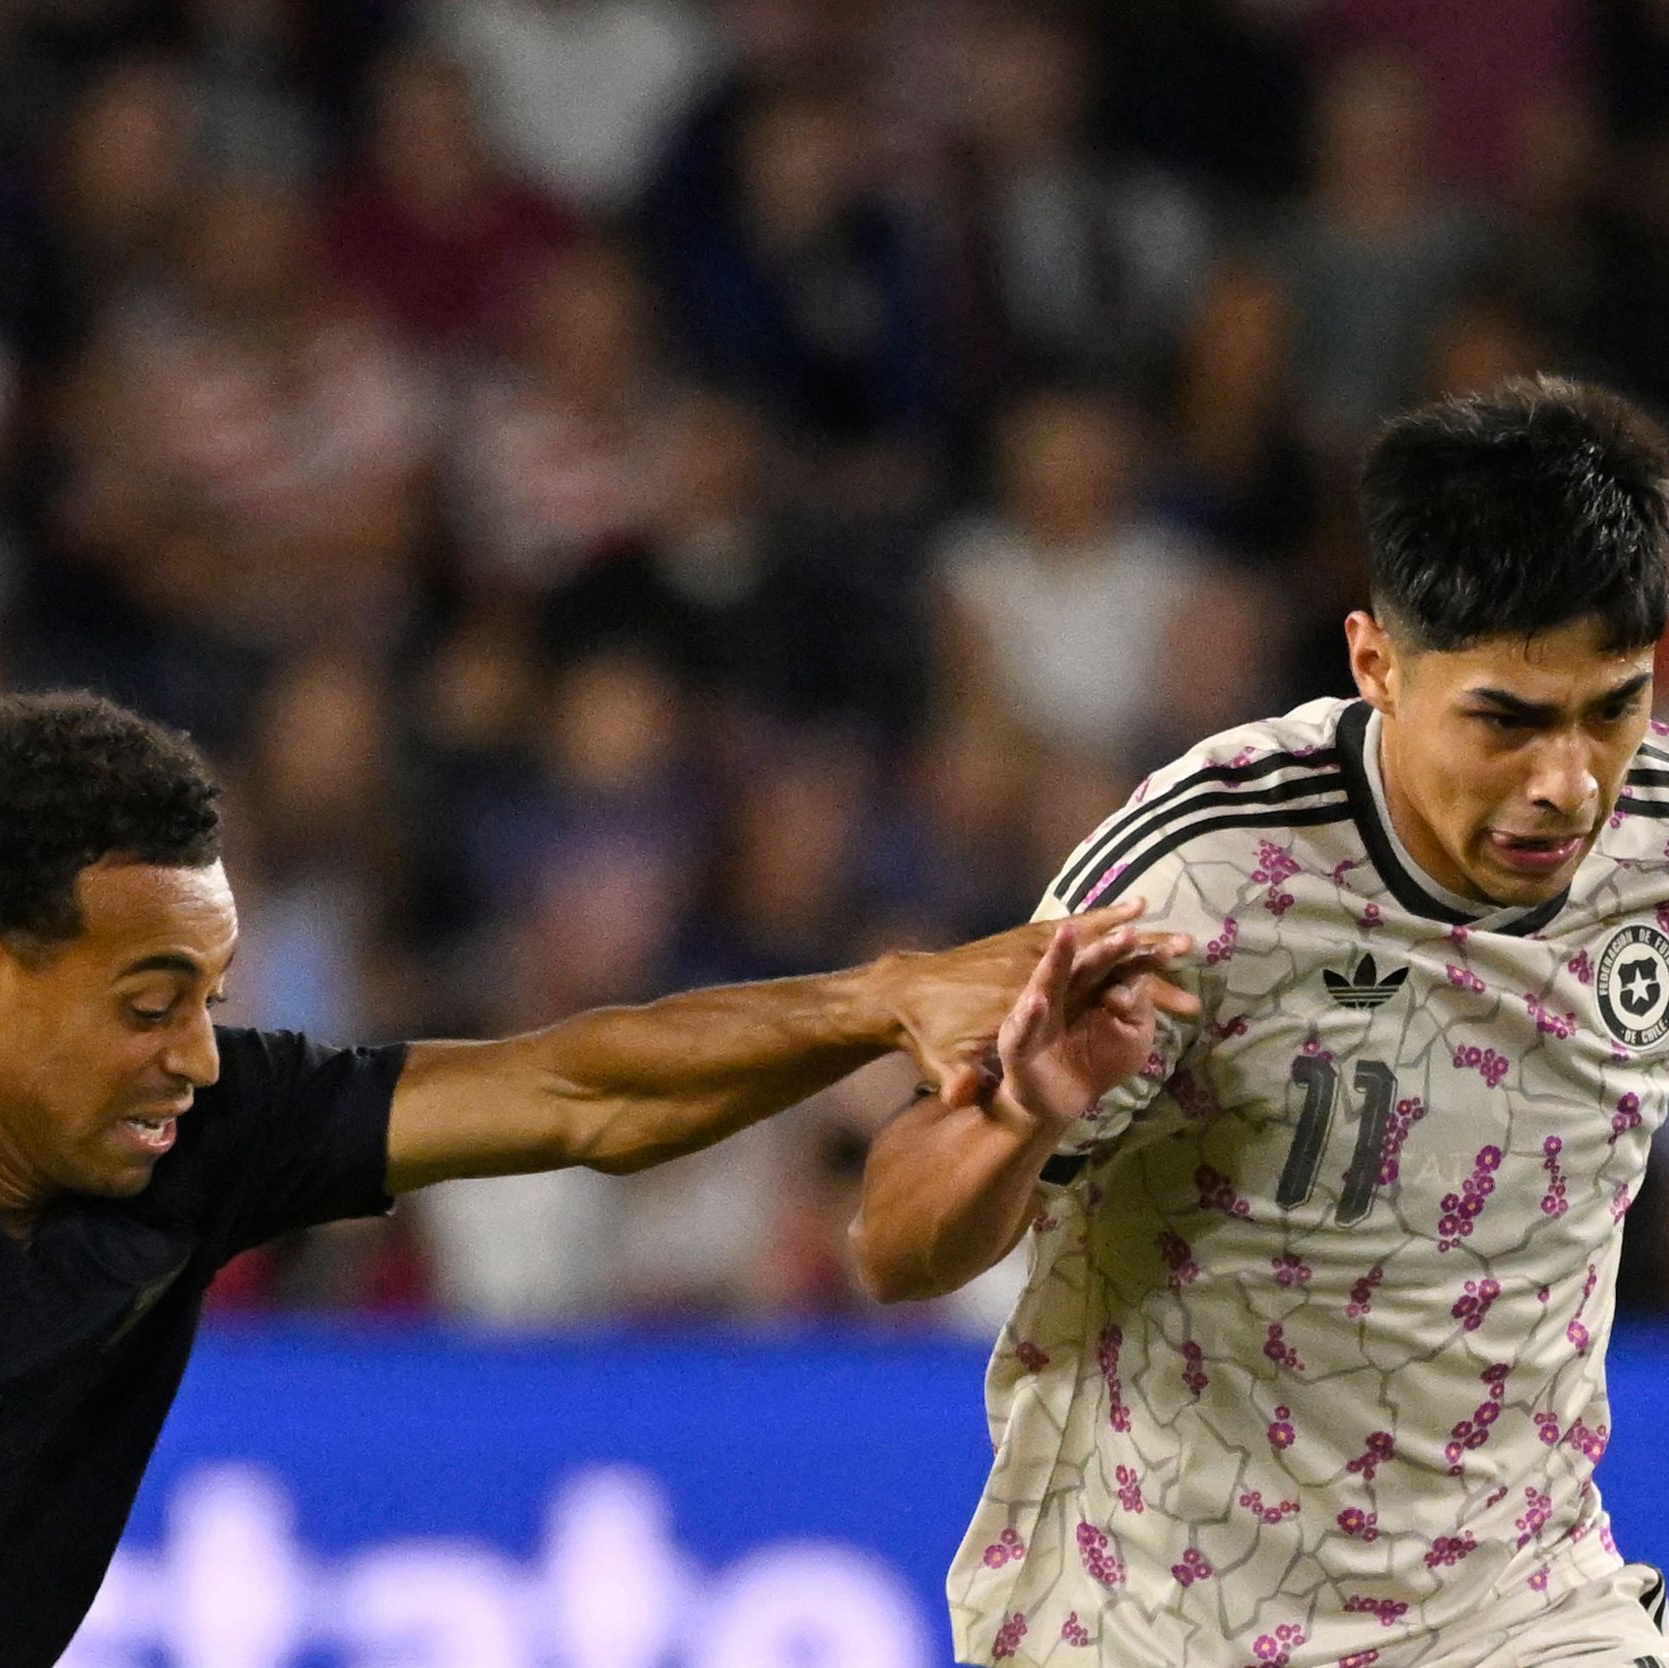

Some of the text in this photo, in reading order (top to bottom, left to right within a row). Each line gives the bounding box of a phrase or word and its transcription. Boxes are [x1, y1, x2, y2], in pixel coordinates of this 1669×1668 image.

[1639, 928, 1651, 944] DE
[1624, 1020, 1667, 1044] DE CHILE
[1276, 1056, 1398, 1229] 11
